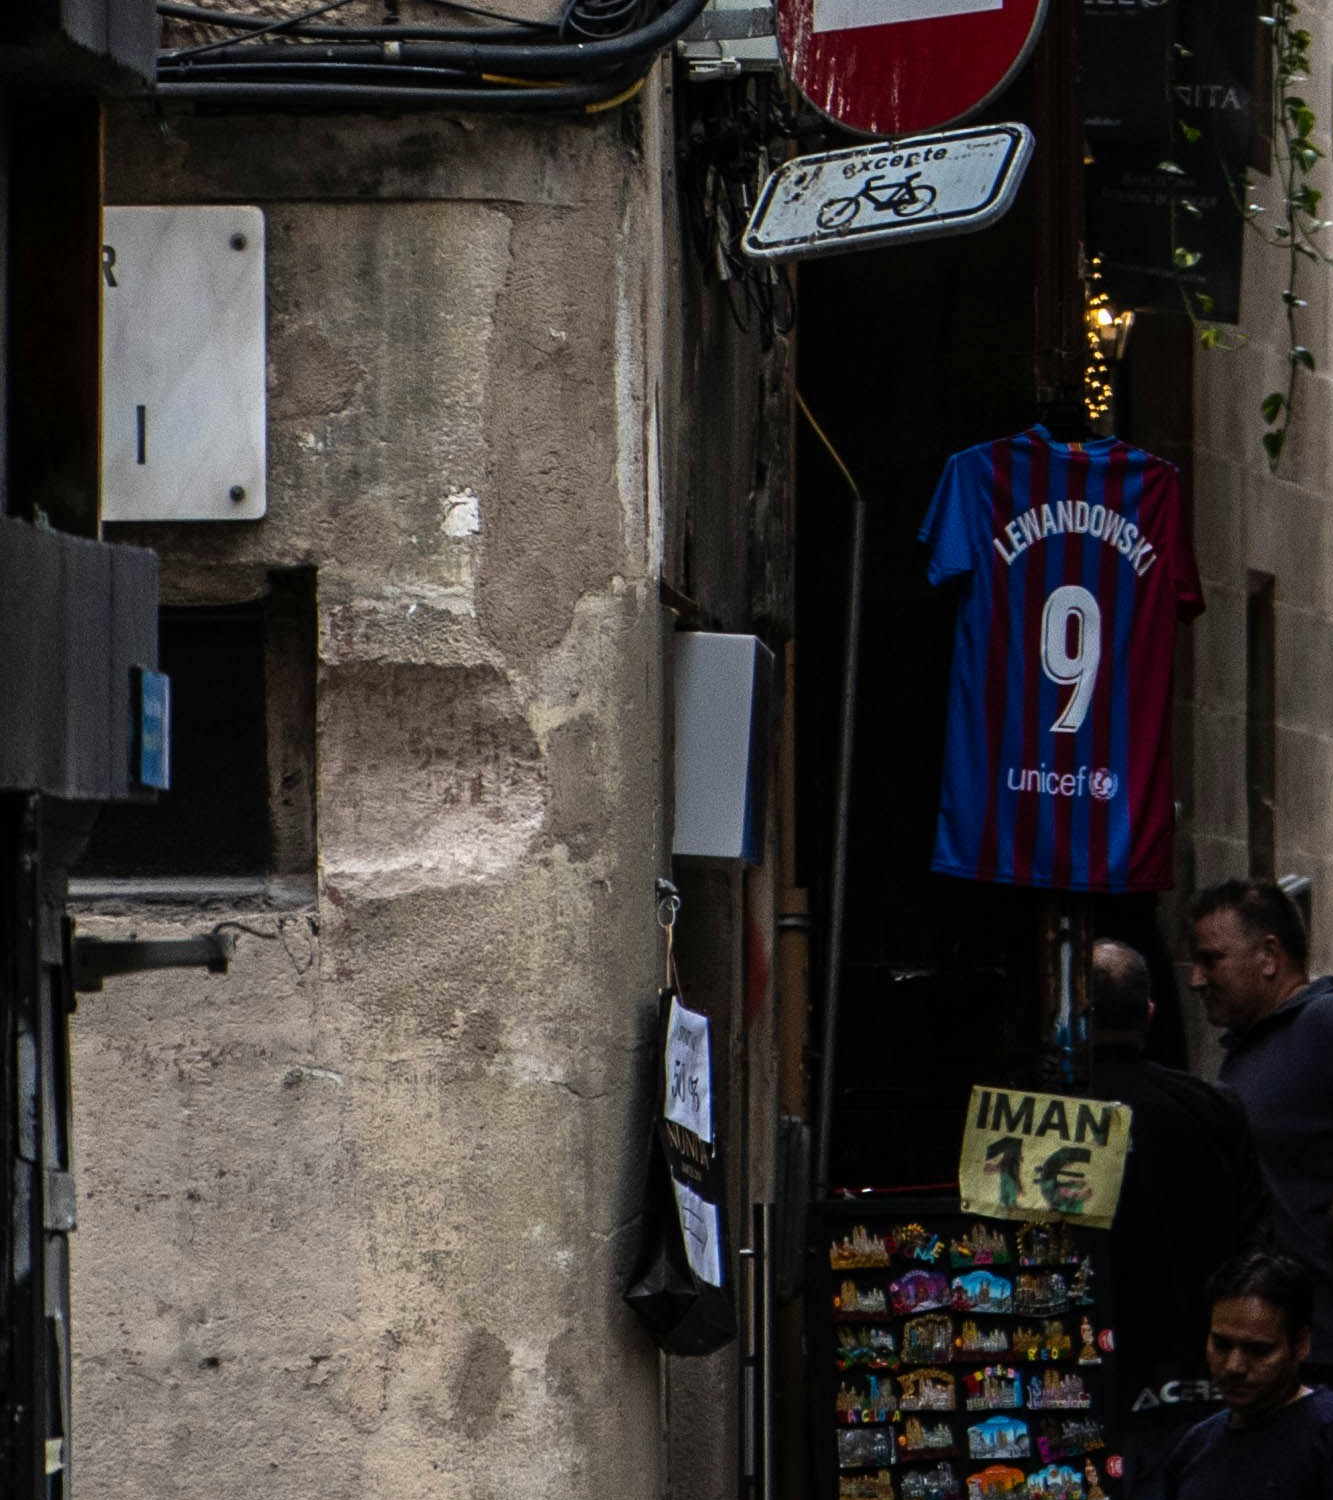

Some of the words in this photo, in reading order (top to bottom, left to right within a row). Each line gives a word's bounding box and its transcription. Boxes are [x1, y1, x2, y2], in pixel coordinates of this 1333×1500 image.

[842, 147, 948, 180] excepte
[992, 499, 1158, 577] LEWANDOWSKI
[1039, 584, 1102, 734] 9
[1007, 763, 1088, 798] unicef
[976, 1091, 1114, 1147] IMAN
[985, 1136, 1094, 1215] 1€
